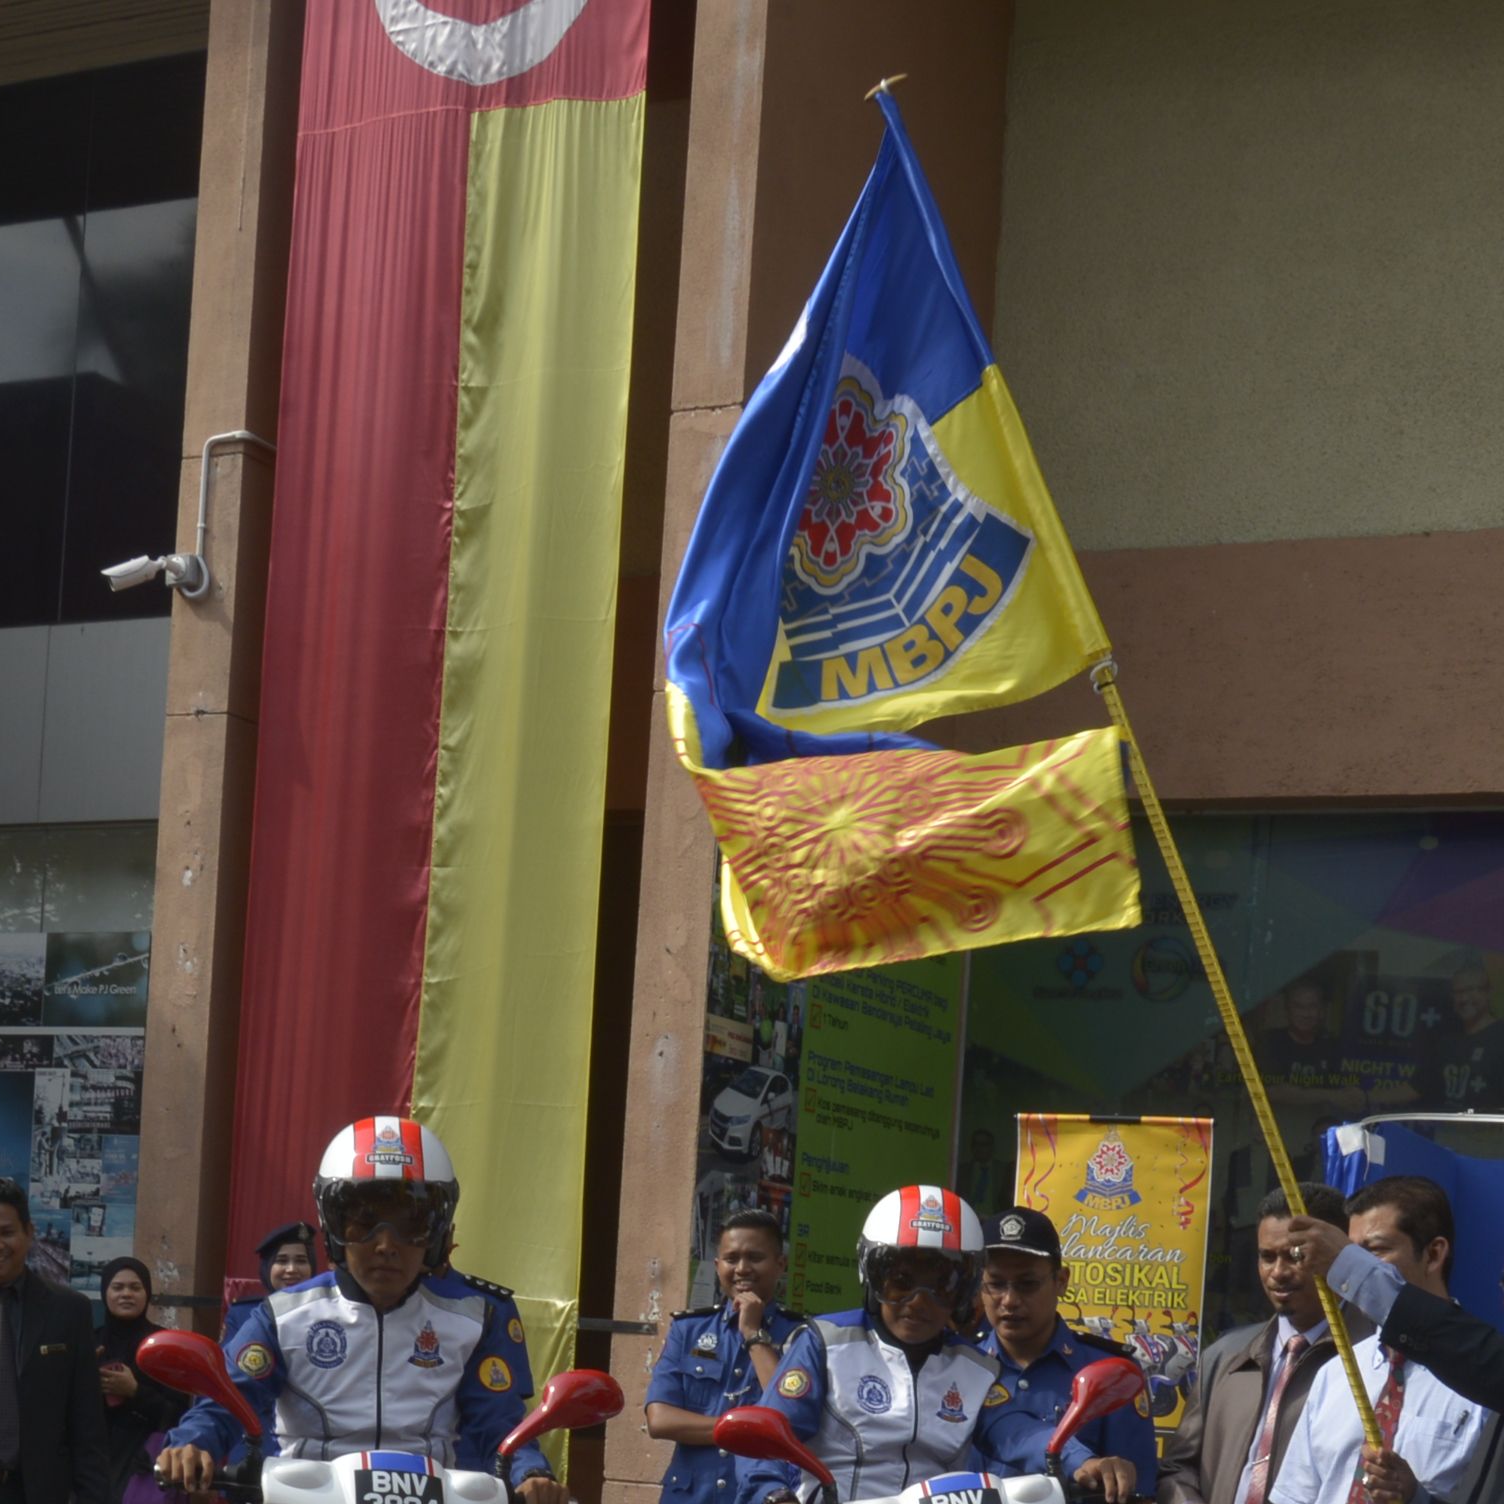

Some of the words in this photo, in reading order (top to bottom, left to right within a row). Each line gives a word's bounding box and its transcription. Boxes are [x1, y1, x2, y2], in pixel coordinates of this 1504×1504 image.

[820, 553, 1004, 701] MBPJ
[1341, 1058, 1395, 1076] NIGHT
[1084, 1193, 1131, 1211] MBPJ
[1061, 1213, 1151, 1248] Majlis
[1061, 1233, 1185, 1264] lancaran
[1062, 1261, 1187, 1290] TOSIKAL
[1094, 1287, 1187, 1309] ELEKTRIK
[371, 1470, 428, 1497] BNV
